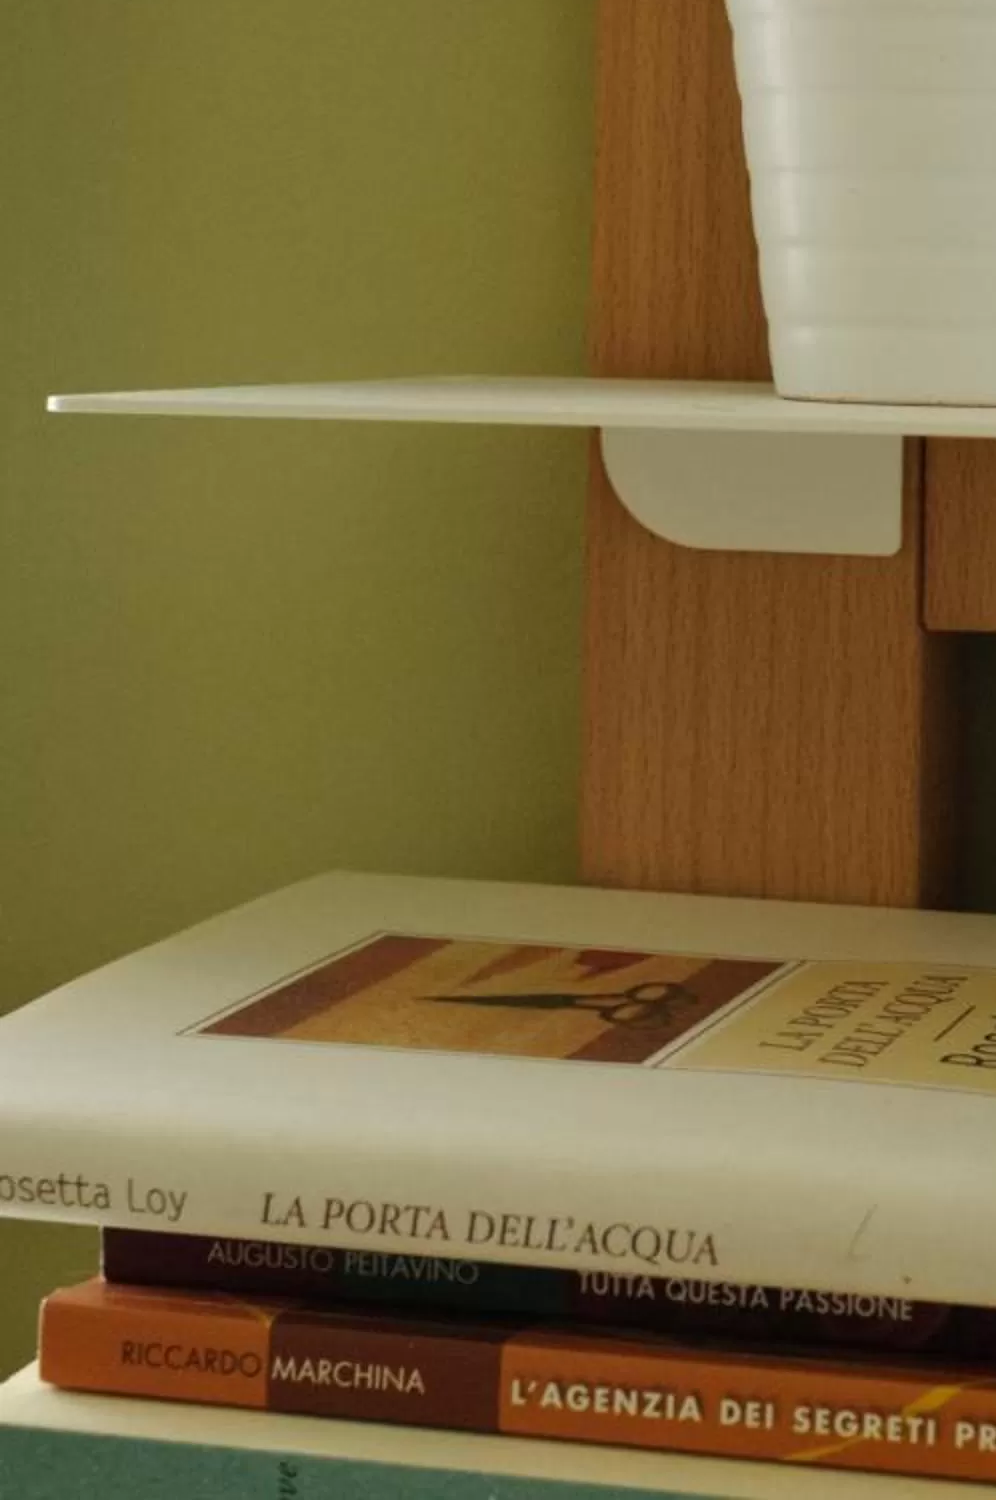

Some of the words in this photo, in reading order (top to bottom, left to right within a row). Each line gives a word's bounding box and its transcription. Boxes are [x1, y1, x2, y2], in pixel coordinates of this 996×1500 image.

[786, 980, 890, 1029] PORTA
[759, 1029, 824, 1053] LA
[0, 1172, 111, 1210] osetta
[127, 1178, 188, 1222] Loy
[260, 1192, 307, 1229] LA
[322, 1199, 450, 1243] PORTA
[466, 1210, 719, 1266] DELL'ACQUA
[207, 1240, 333, 1272] AUGUSTO
[578, 1271, 656, 1301] TUTTA
[665, 1278, 768, 1309] QUESTA
[779, 1287, 914, 1323] PASSIONE
[120, 1340, 262, 1379] RICCARDO
[271, 1356, 426, 1396] MARCHINA
[511, 1379, 701, 1422] L'AGENZIA
[720, 1400, 774, 1430] DEI
[793, 1406, 936, 1447] SEGRETI
